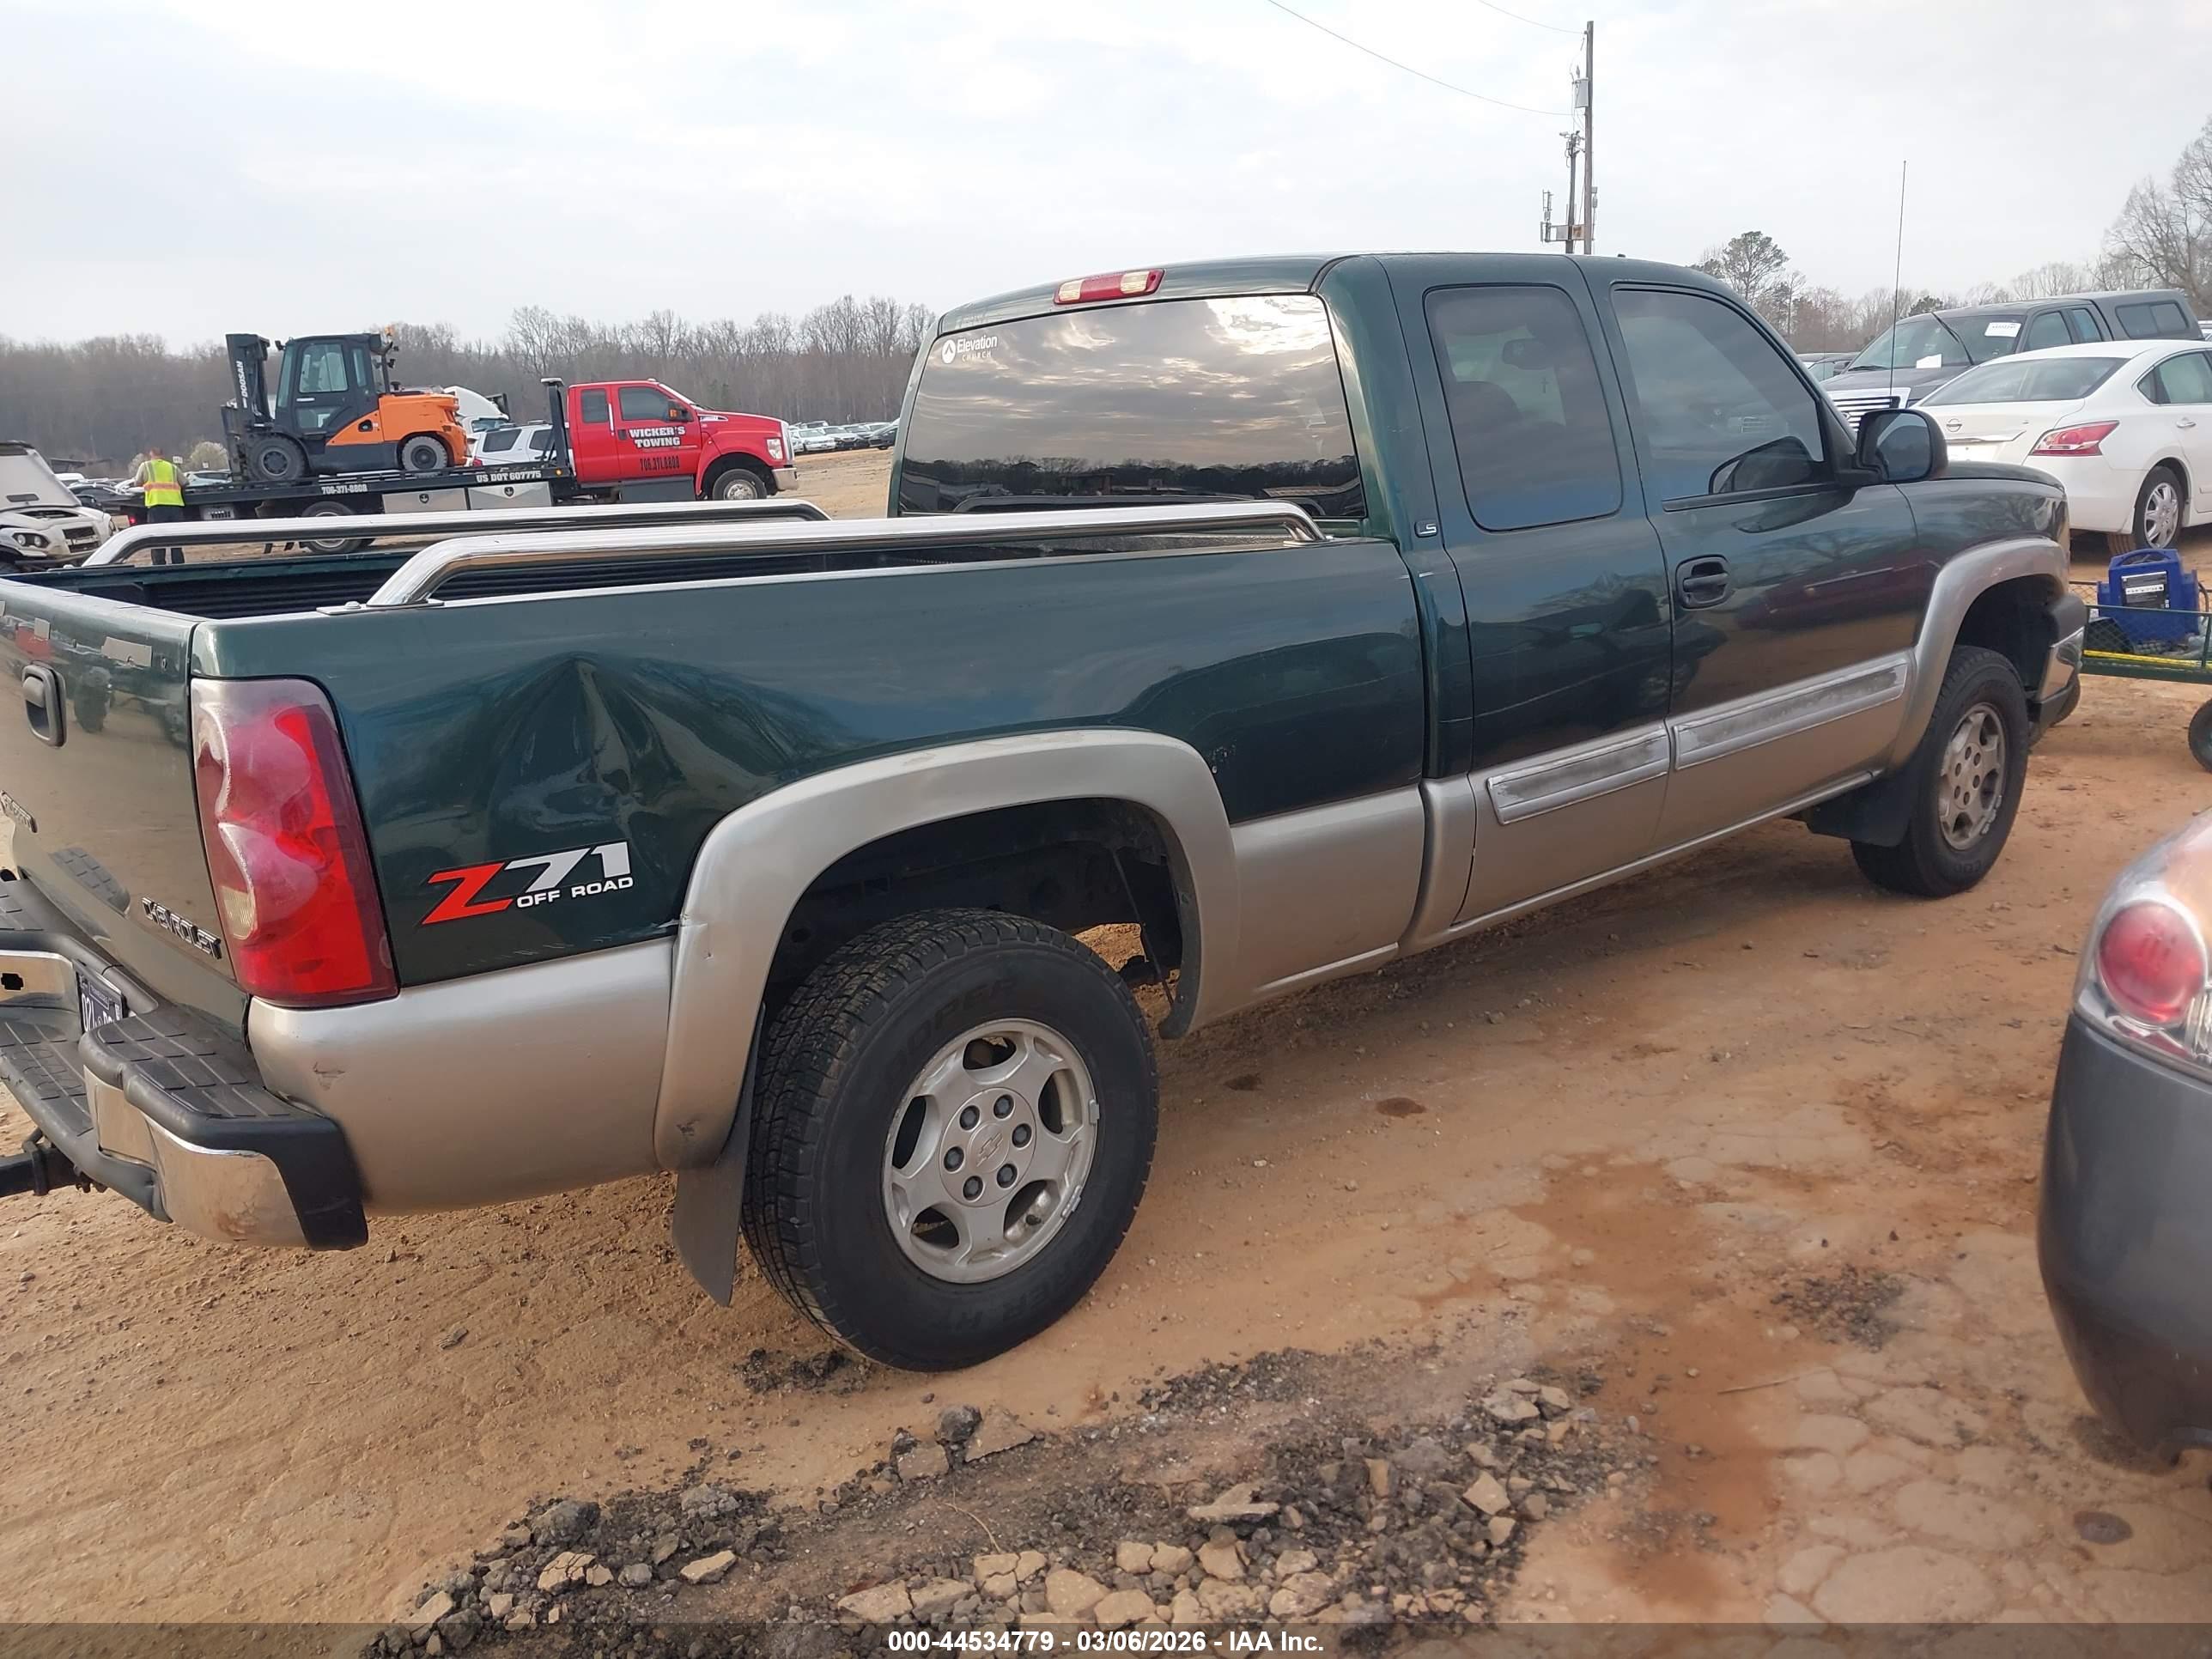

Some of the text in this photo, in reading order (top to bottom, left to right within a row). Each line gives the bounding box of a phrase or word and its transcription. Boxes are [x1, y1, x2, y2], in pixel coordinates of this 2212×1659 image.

[957, 334, 998, 353] Elevation
[962, 349, 992, 362] CHURCH
[236, 360, 248, 398] DOOSAN
[629, 426, 685, 439] WICKER'S
[635, 437, 681, 448] TOWING
[476, 470, 542, 483] US DOT 607775
[422, 841, 631, 926] Z71
[517, 876, 634, 908] OFF ROAD
